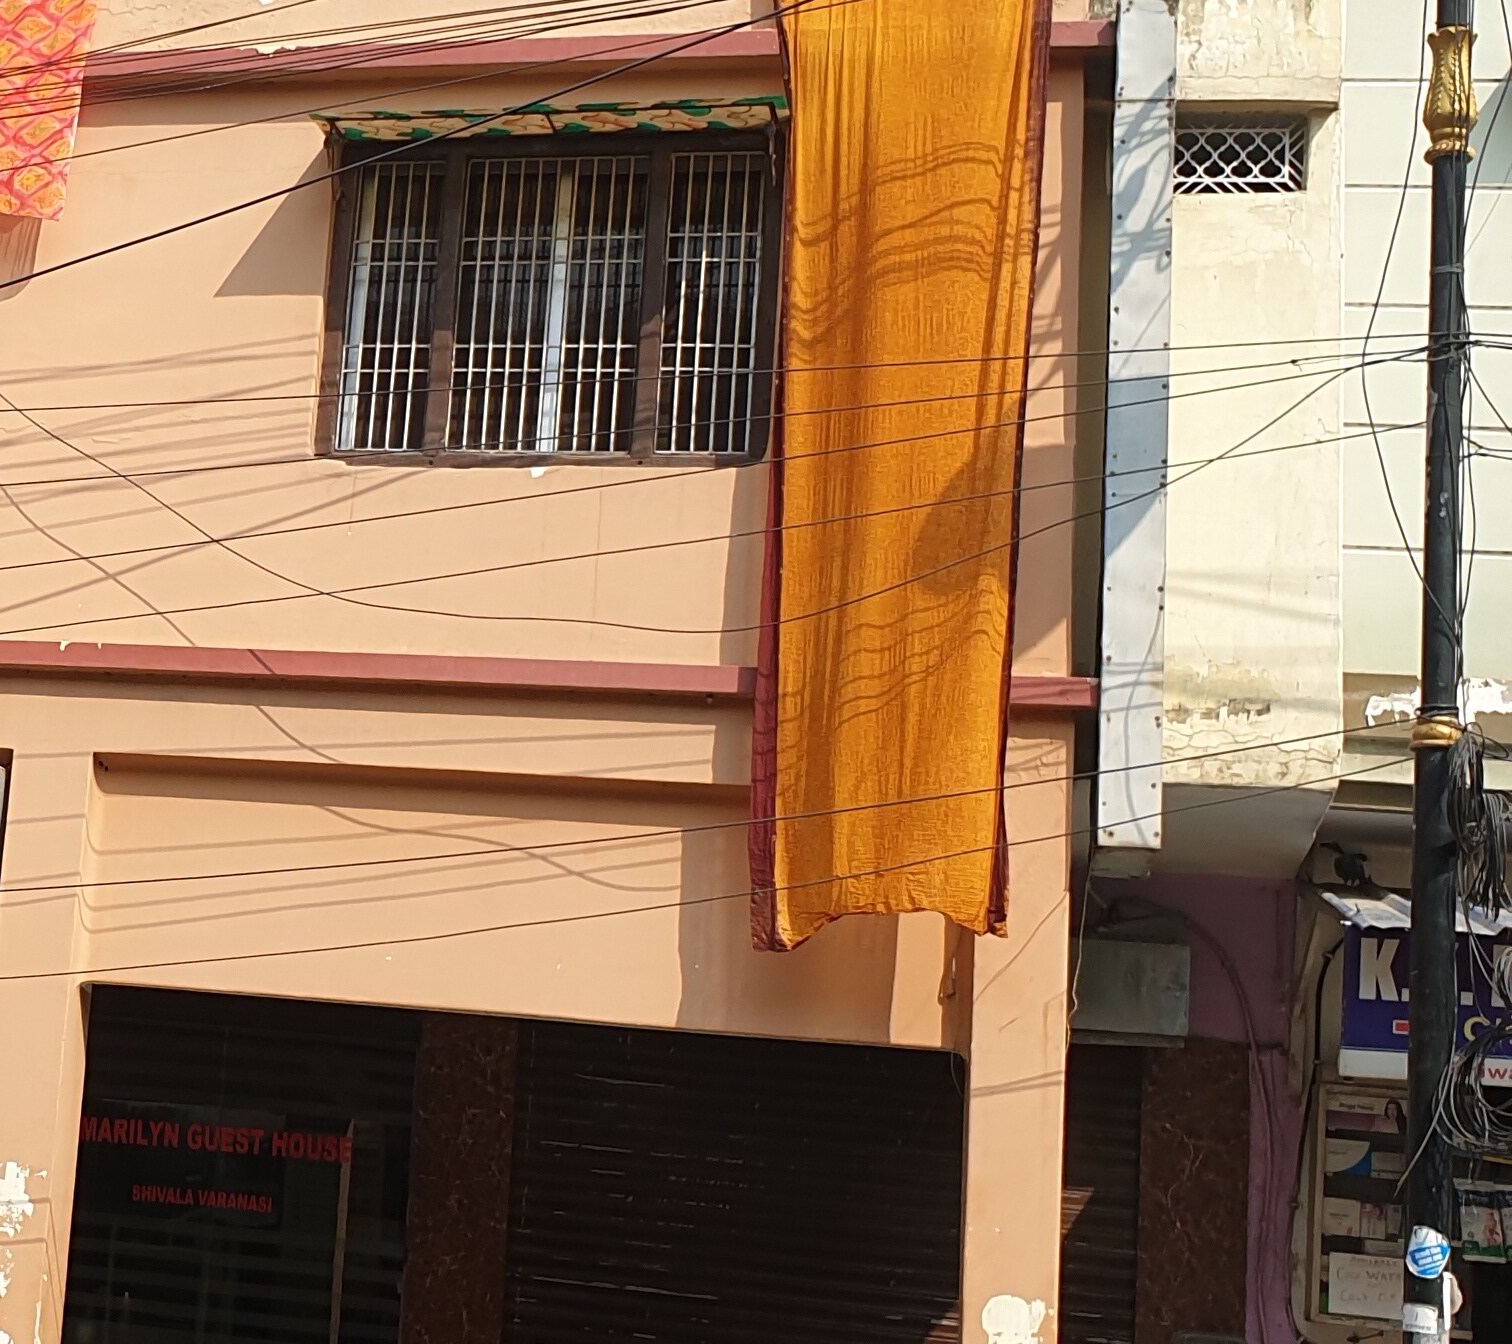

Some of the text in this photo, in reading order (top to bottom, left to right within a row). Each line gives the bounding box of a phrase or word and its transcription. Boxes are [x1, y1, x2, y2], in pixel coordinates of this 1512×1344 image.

[81, 1116, 354, 1164] MARILYN GUEST HOUSE
[132, 1184, 273, 1214] SHIVALA VARANASI
